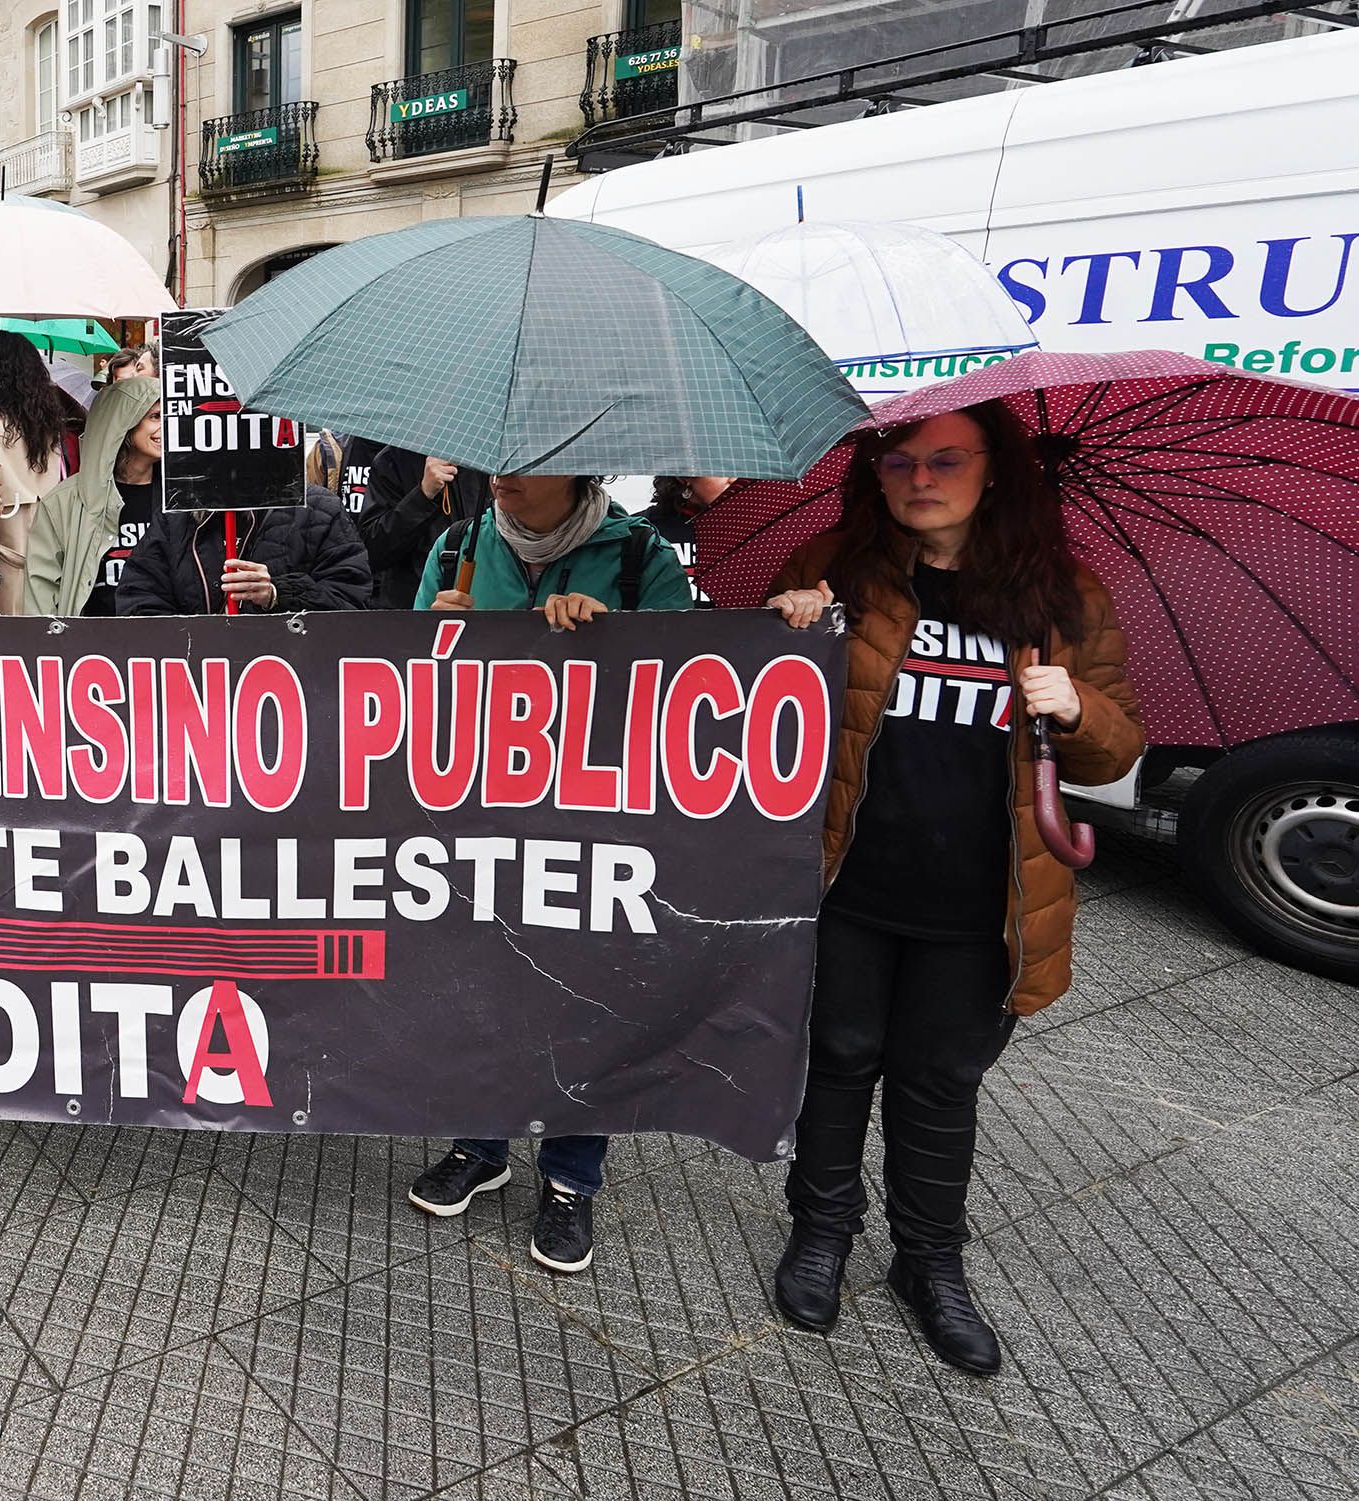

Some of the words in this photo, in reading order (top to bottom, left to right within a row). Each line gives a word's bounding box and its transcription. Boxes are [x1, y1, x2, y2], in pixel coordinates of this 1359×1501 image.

[628, 54, 647, 66] 626
[650, 52, 662, 62] 77
[664, 48, 677, 60] 36
[637, 58, 680, 73] YDEAS.ES
[399, 93, 459, 118] YDEAS
[167, 400, 193, 416] EN
[167, 414, 300, 452] LOITA
[338, 619, 831, 821] PÚBLICO
[95, 831, 658, 934] BALLESTER
